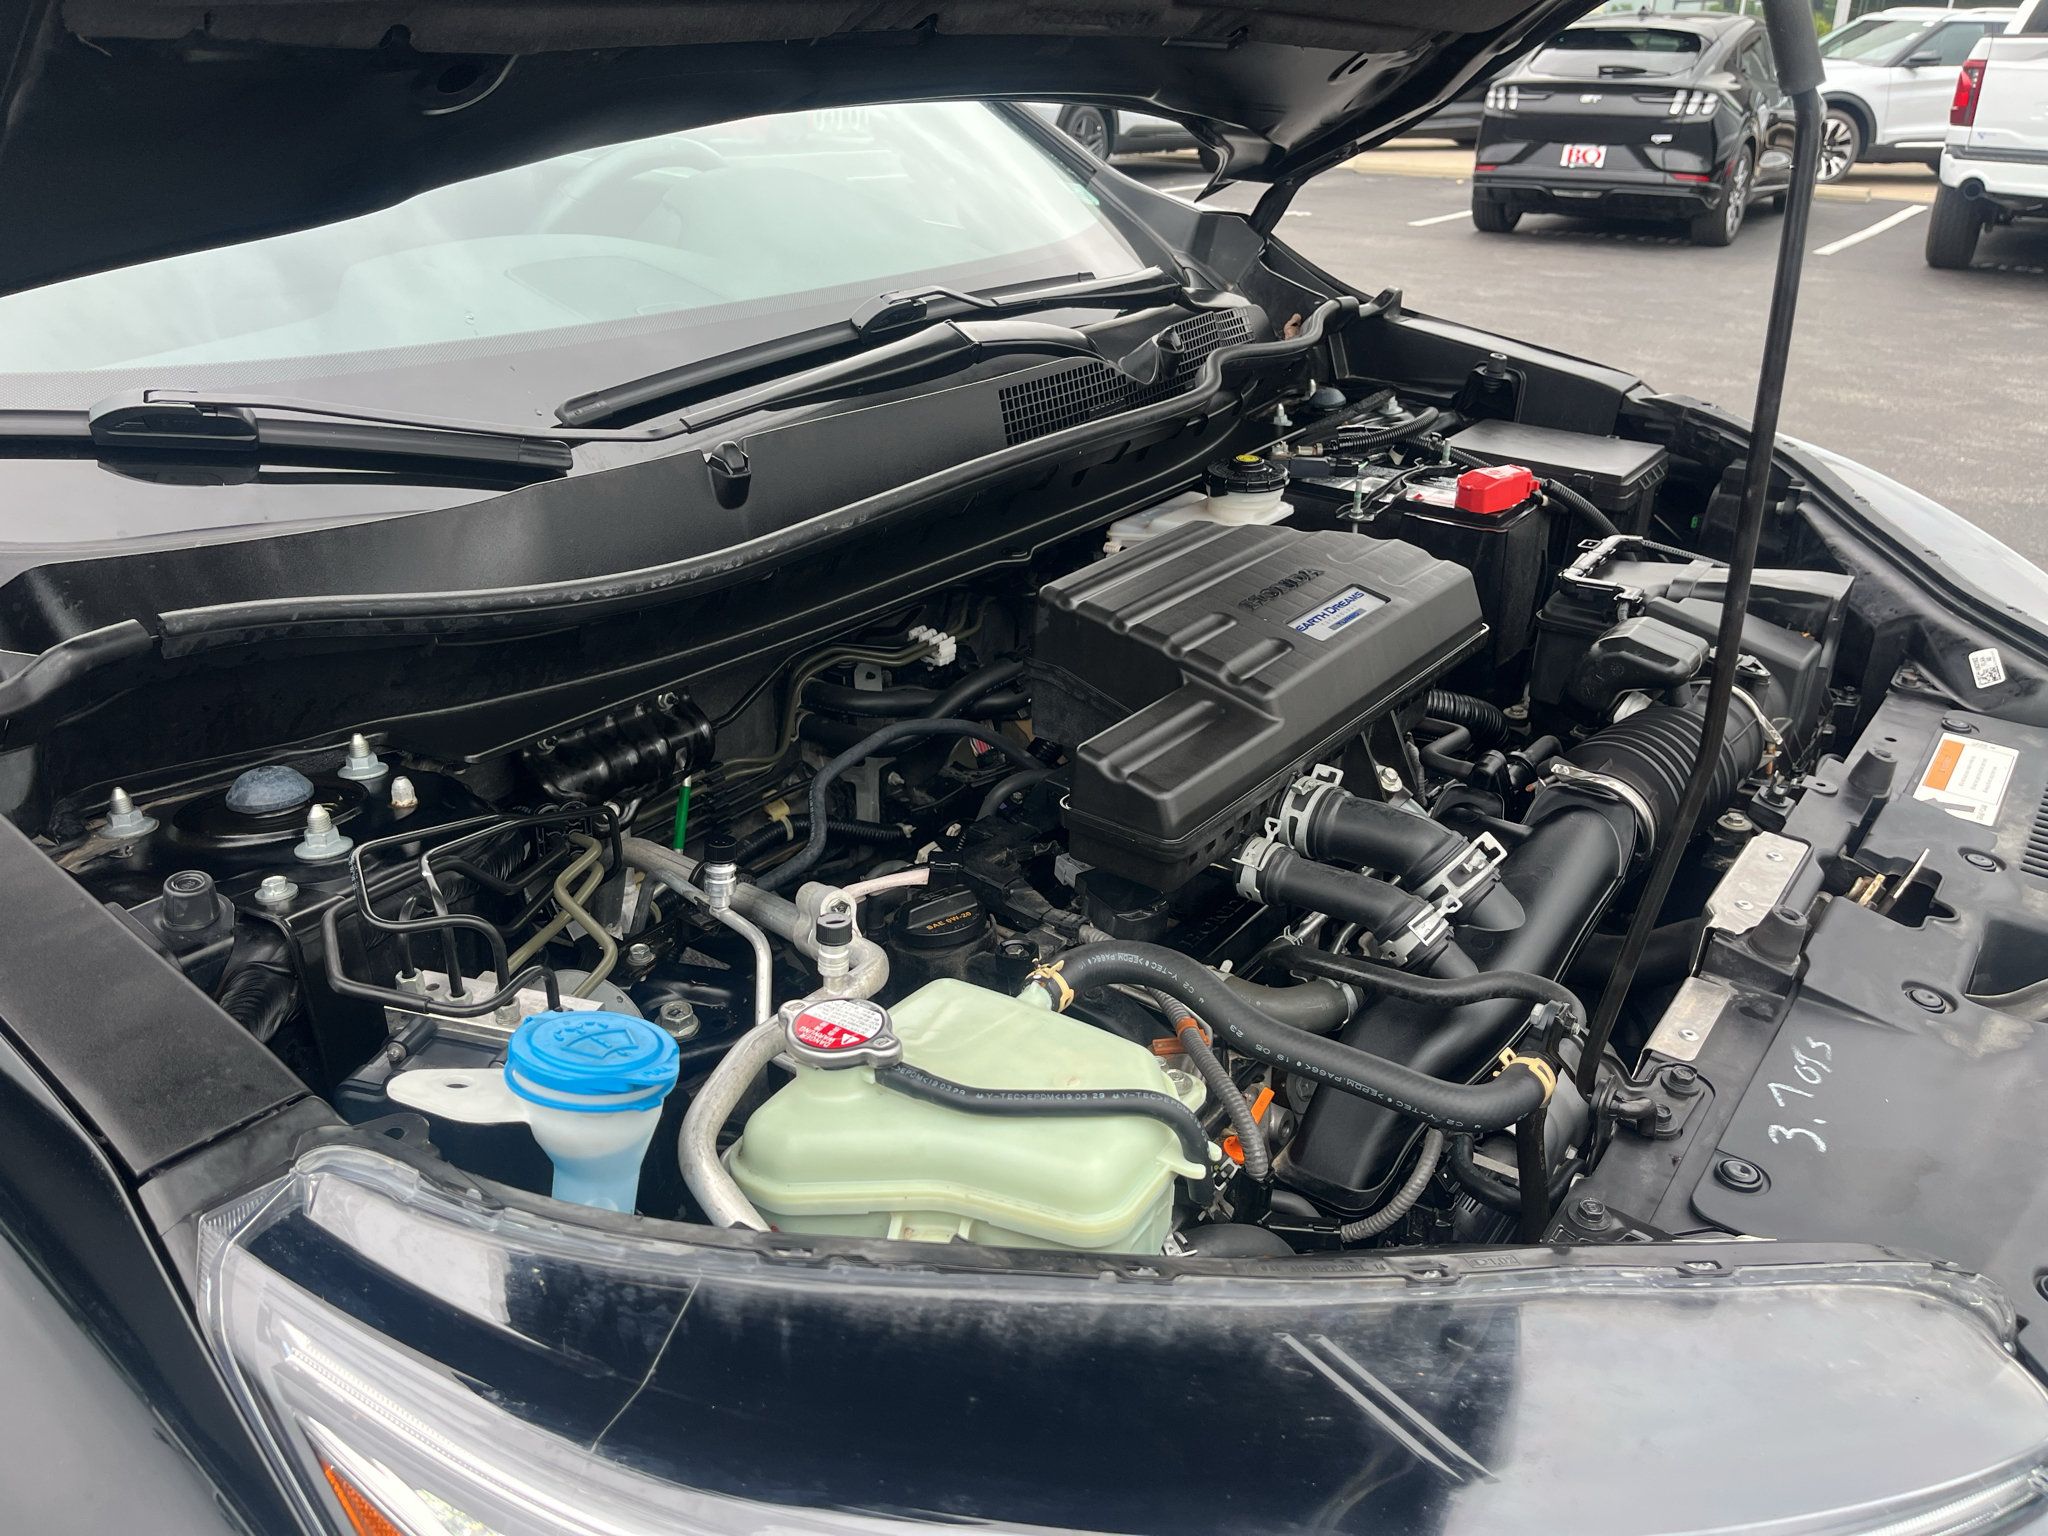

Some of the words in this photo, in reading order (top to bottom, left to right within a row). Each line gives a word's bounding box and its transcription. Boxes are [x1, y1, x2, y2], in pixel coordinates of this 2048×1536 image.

[1239, 568, 1325, 611] HONDA
[1295, 611, 1330, 633] EARTH
[1324, 591, 1365, 615] DREAMS
[926, 921, 945, 930] SAE
